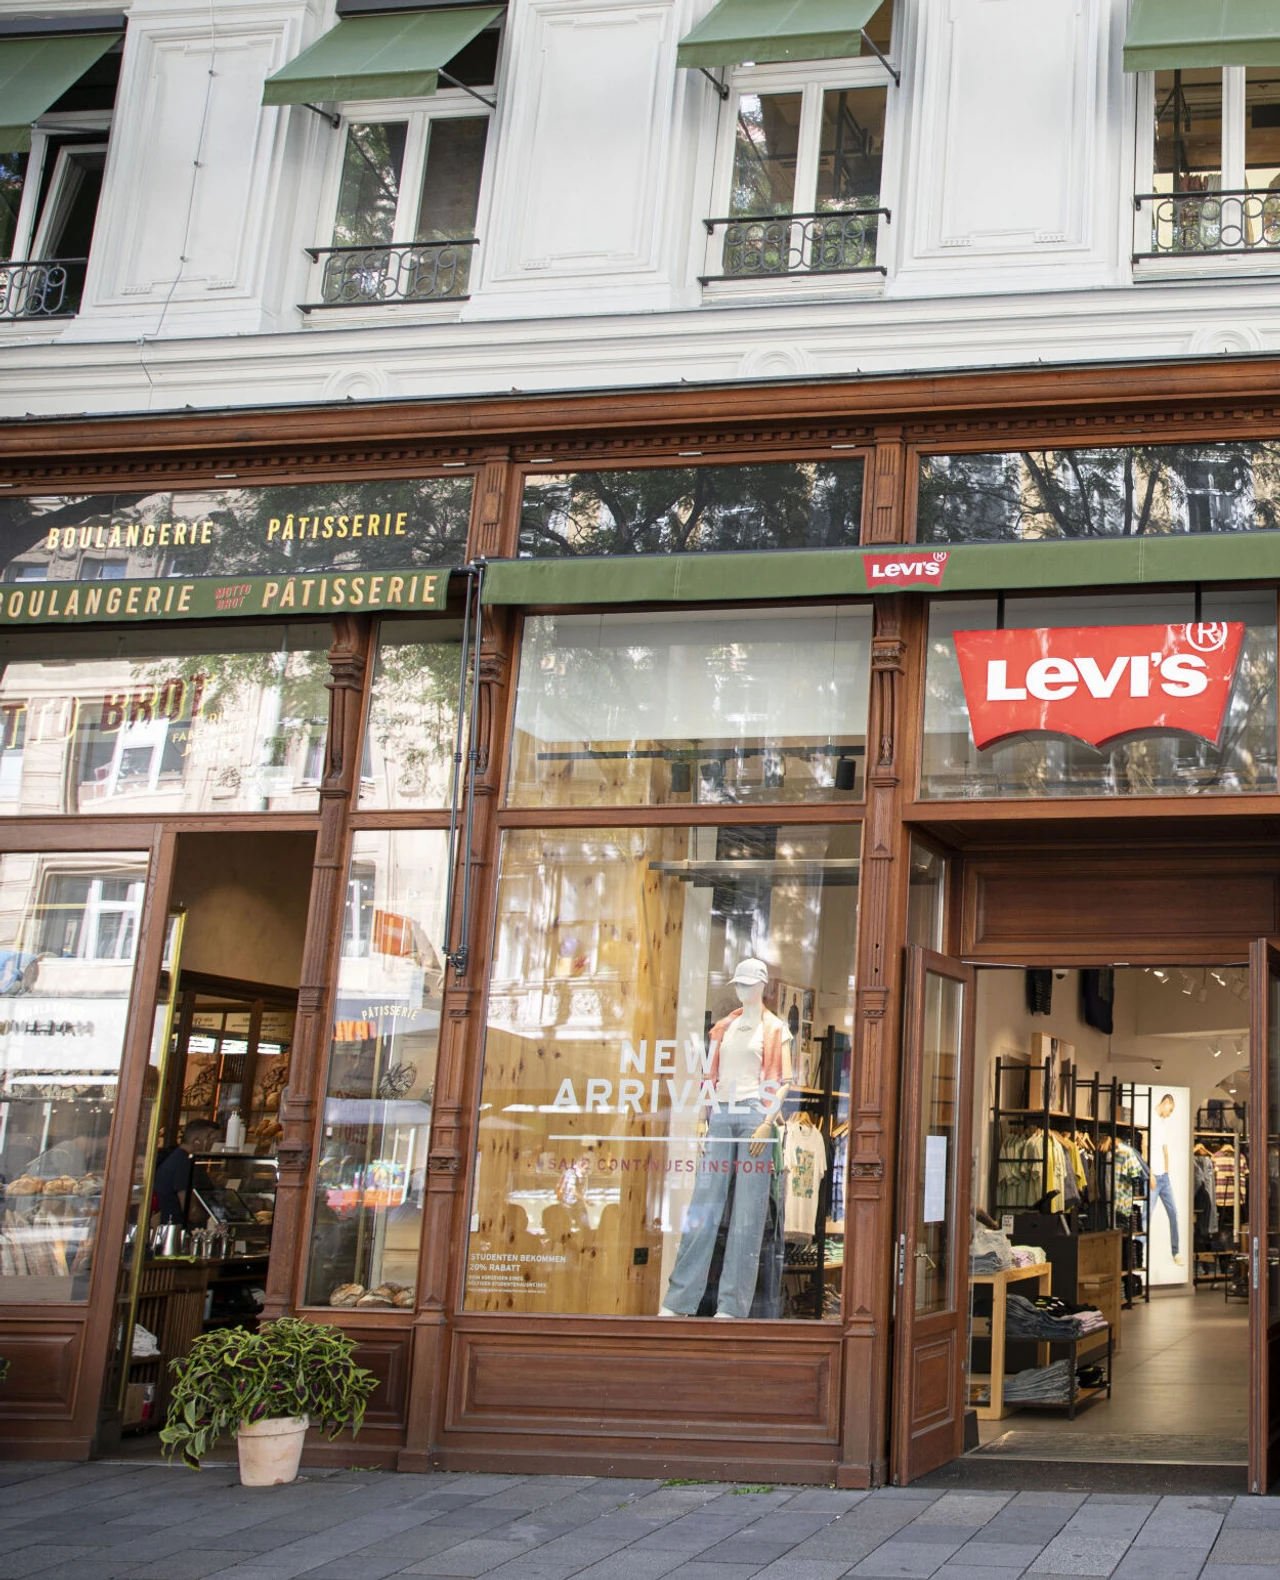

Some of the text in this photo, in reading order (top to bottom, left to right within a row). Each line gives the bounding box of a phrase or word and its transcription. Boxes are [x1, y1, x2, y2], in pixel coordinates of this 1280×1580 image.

[46, 512, 409, 550] BOULANGERIE PÂTISSERIE
[0, 584, 195, 618] OULANGERIE
[261, 575, 438, 609] PÂTISSERIE
[100, 674, 216, 735] BROT
[620, 1038, 719, 1074] NEW
[553, 1078, 783, 1115] ARRIVALS
[548, 1158, 777, 1174] SALE CONTINUES INSTORE
[469, 1263, 521, 1271] 20% RABATT
[471, 1253, 567, 1263] STUDENTEN BEKOMMEN
